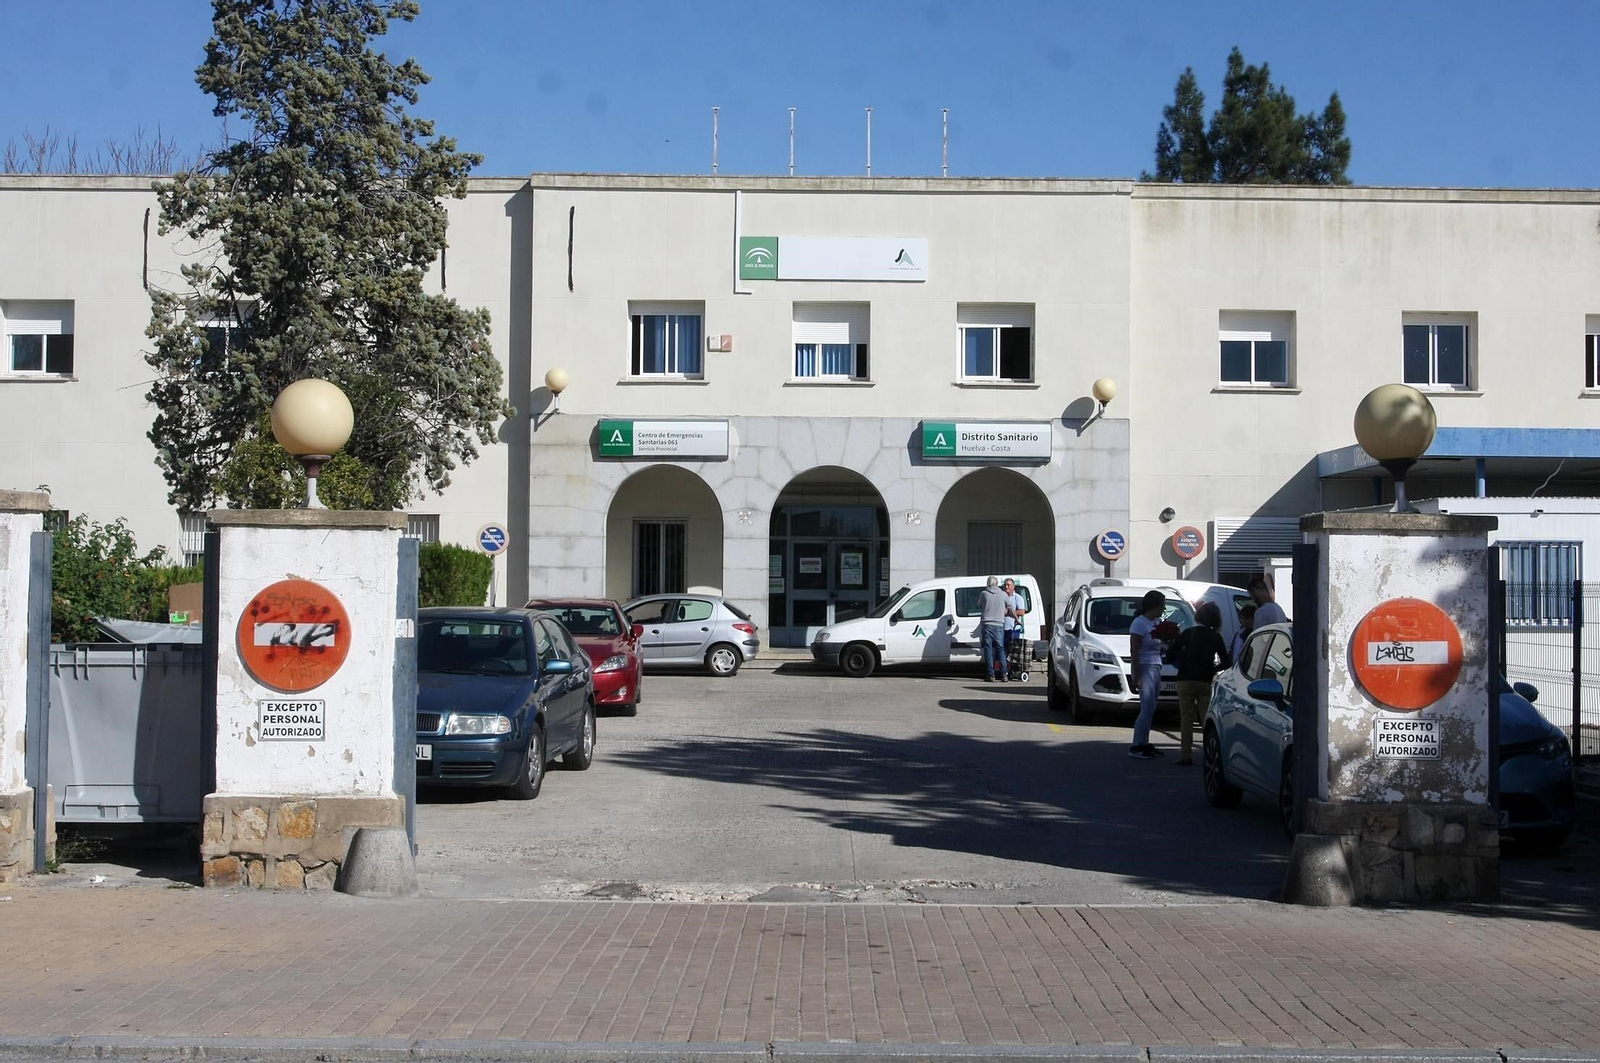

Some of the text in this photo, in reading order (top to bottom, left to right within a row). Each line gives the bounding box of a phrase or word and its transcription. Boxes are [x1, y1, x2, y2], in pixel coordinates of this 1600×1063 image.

[962, 433, 1039, 442] Distrito Sanitario
[267, 703, 318, 712] EXCEPTO
[263, 715, 322, 724] PERSONAL
[1383, 721, 1434, 732] EXCEPTO
[262, 727, 322, 737] AUTORIZADO
[1379, 733, 1437, 744] PERSONAL
[1378, 746, 1438, 756] AUTORIZADO
